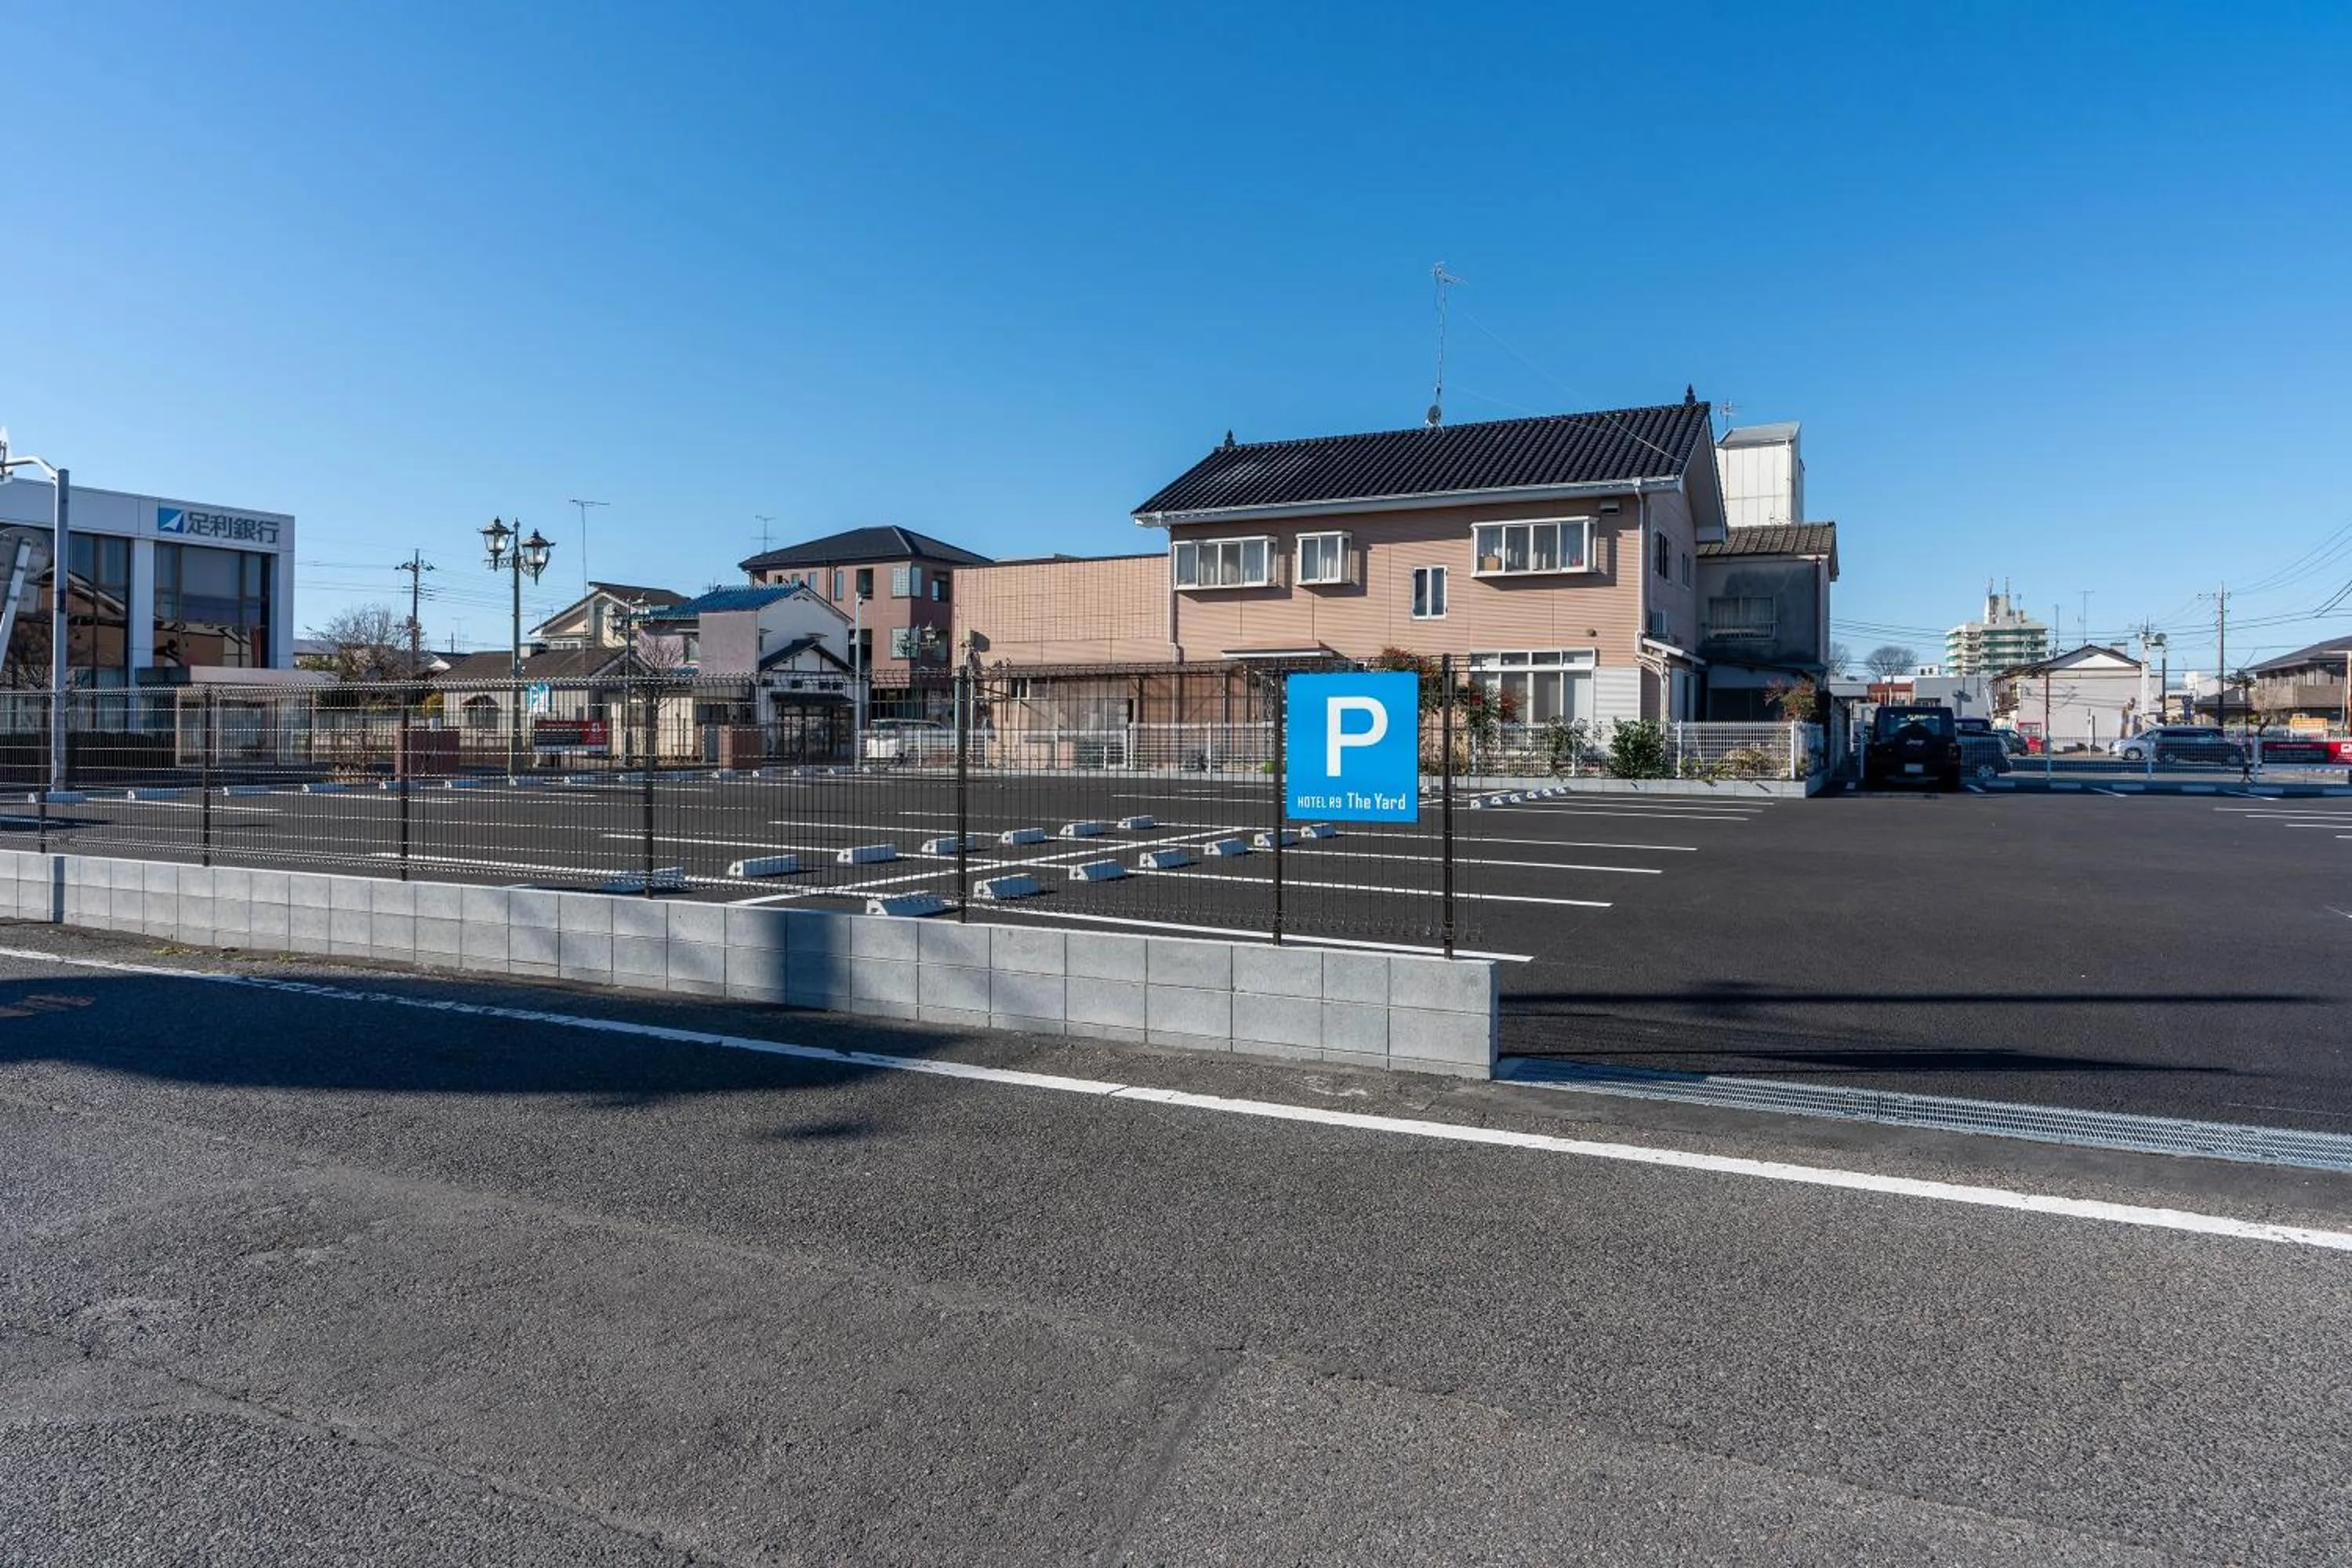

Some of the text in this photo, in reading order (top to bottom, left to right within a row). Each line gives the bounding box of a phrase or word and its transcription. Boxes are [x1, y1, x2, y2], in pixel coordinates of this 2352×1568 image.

[187, 511, 279, 543] 足利銀行
[1327, 696, 1388, 777] P
[1298, 792, 1406, 810] HOTEL R9 The Yard
